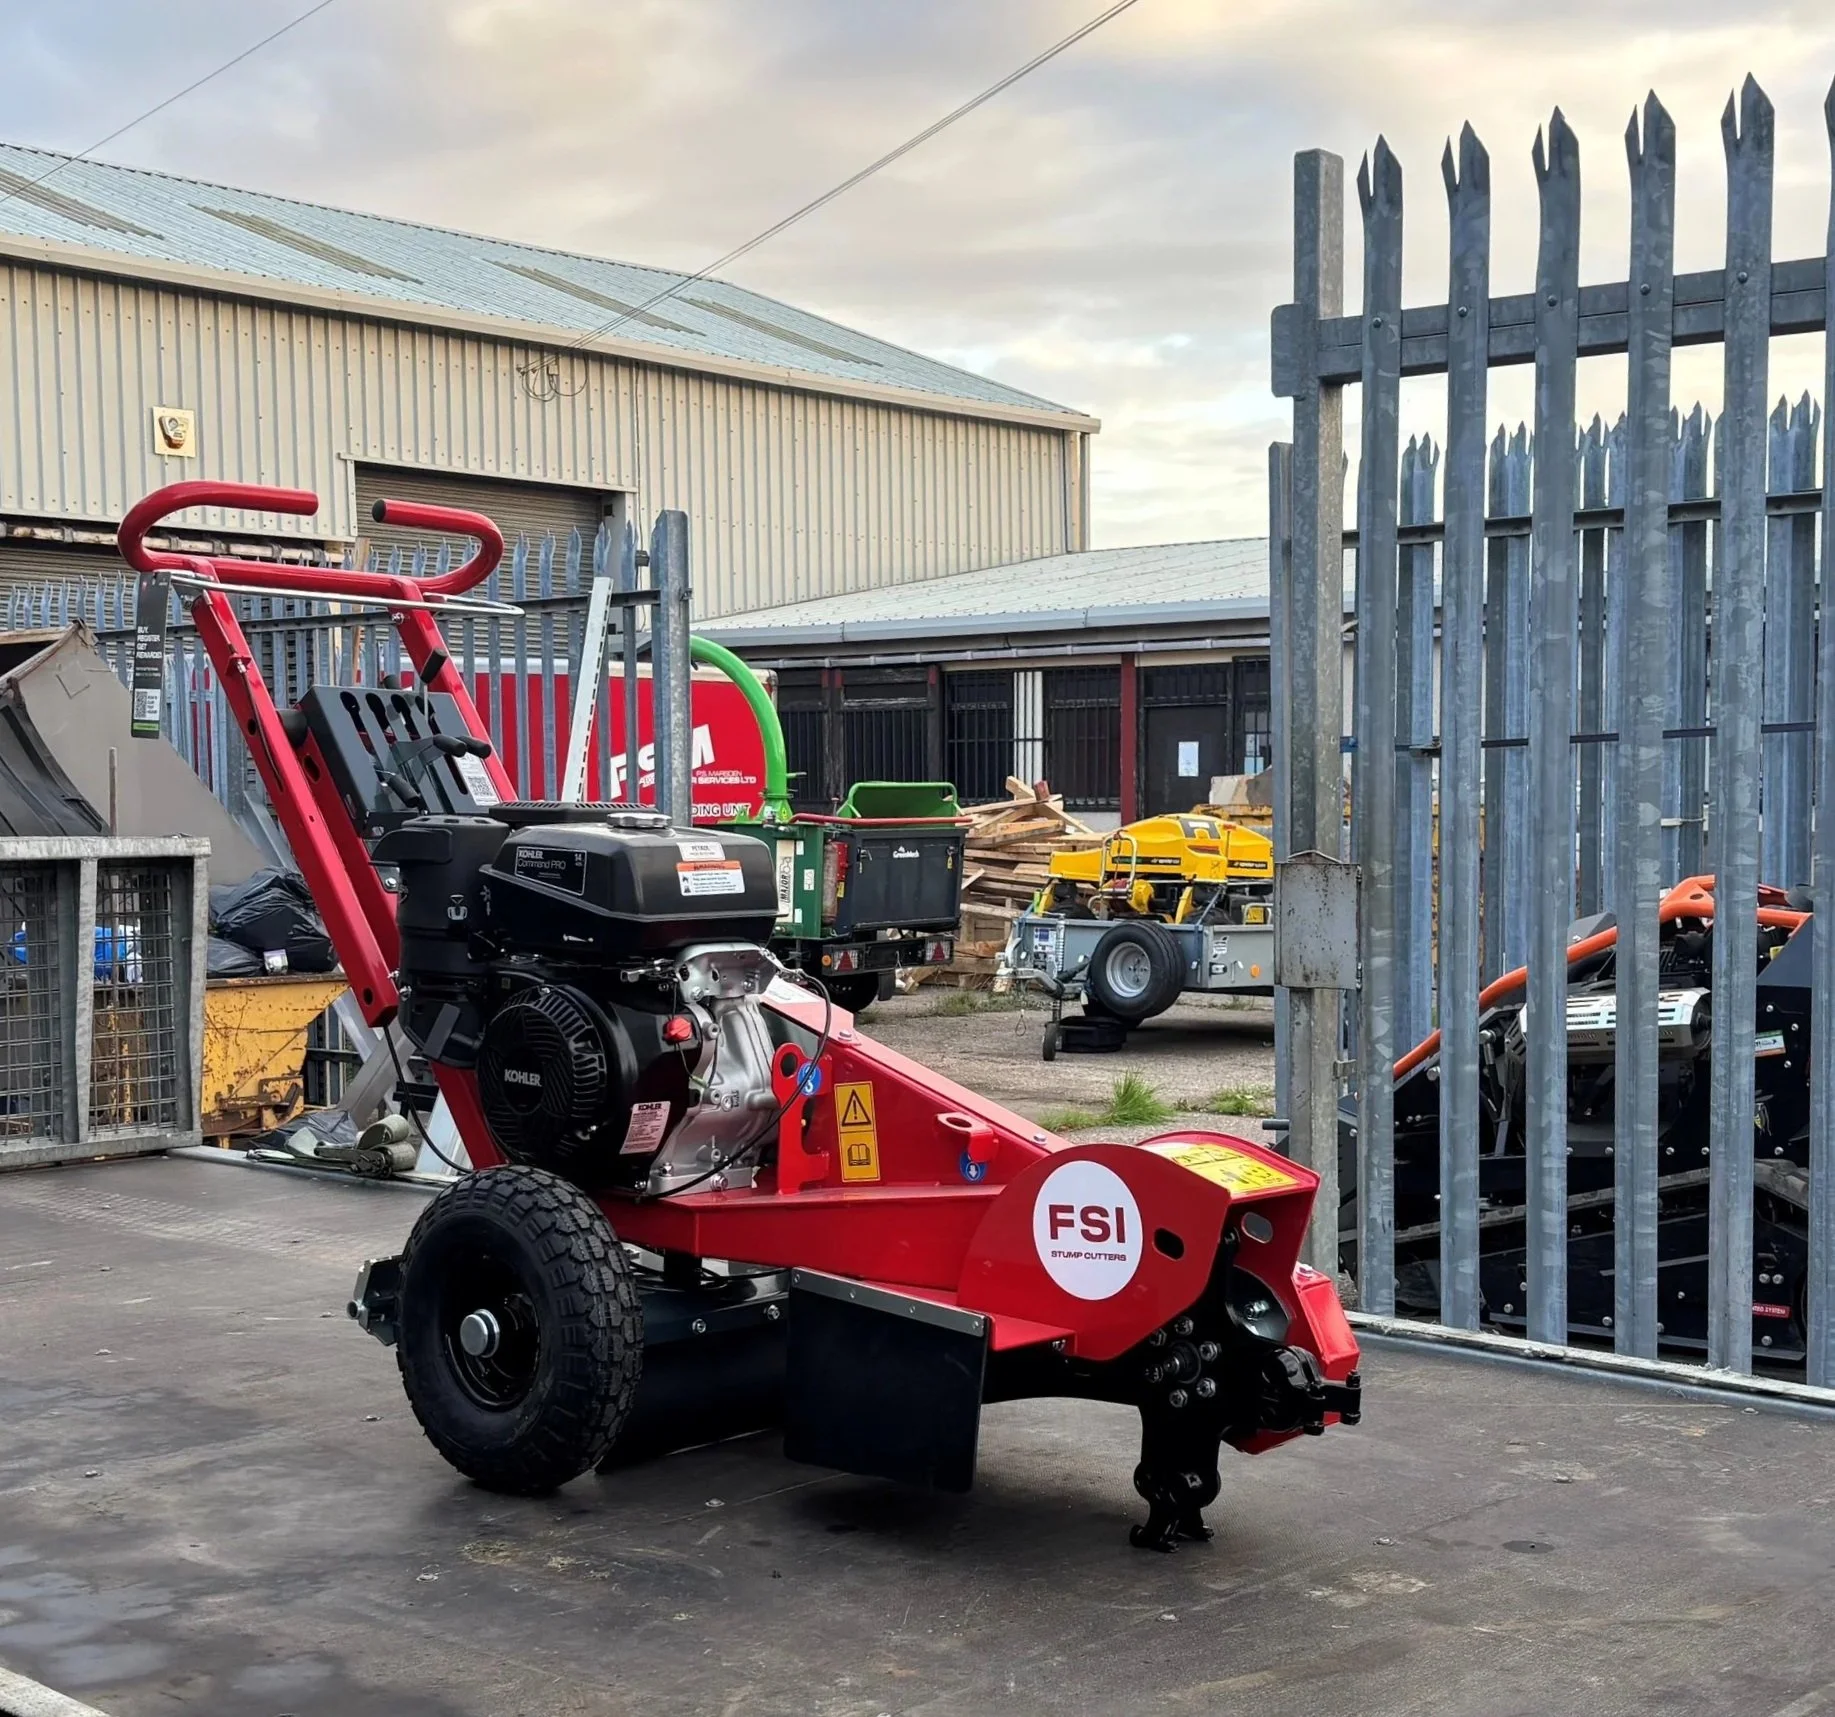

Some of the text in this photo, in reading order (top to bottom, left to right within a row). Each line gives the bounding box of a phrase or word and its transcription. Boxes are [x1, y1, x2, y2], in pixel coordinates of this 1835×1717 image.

[698, 776, 739, 785] SERVICES
[740, 776, 757, 784] LTD
[518, 850, 544, 859] KOHLER
[517, 858, 550, 869] Command
[551, 860, 567, 870] PRO
[780, 874, 788, 900] MAJOR
[504, 1069, 542, 1087] KOHLER
[1048, 1204, 1126, 1244] FSI
[1051, 1250, 1127, 1262] STUMP CUTTERS
